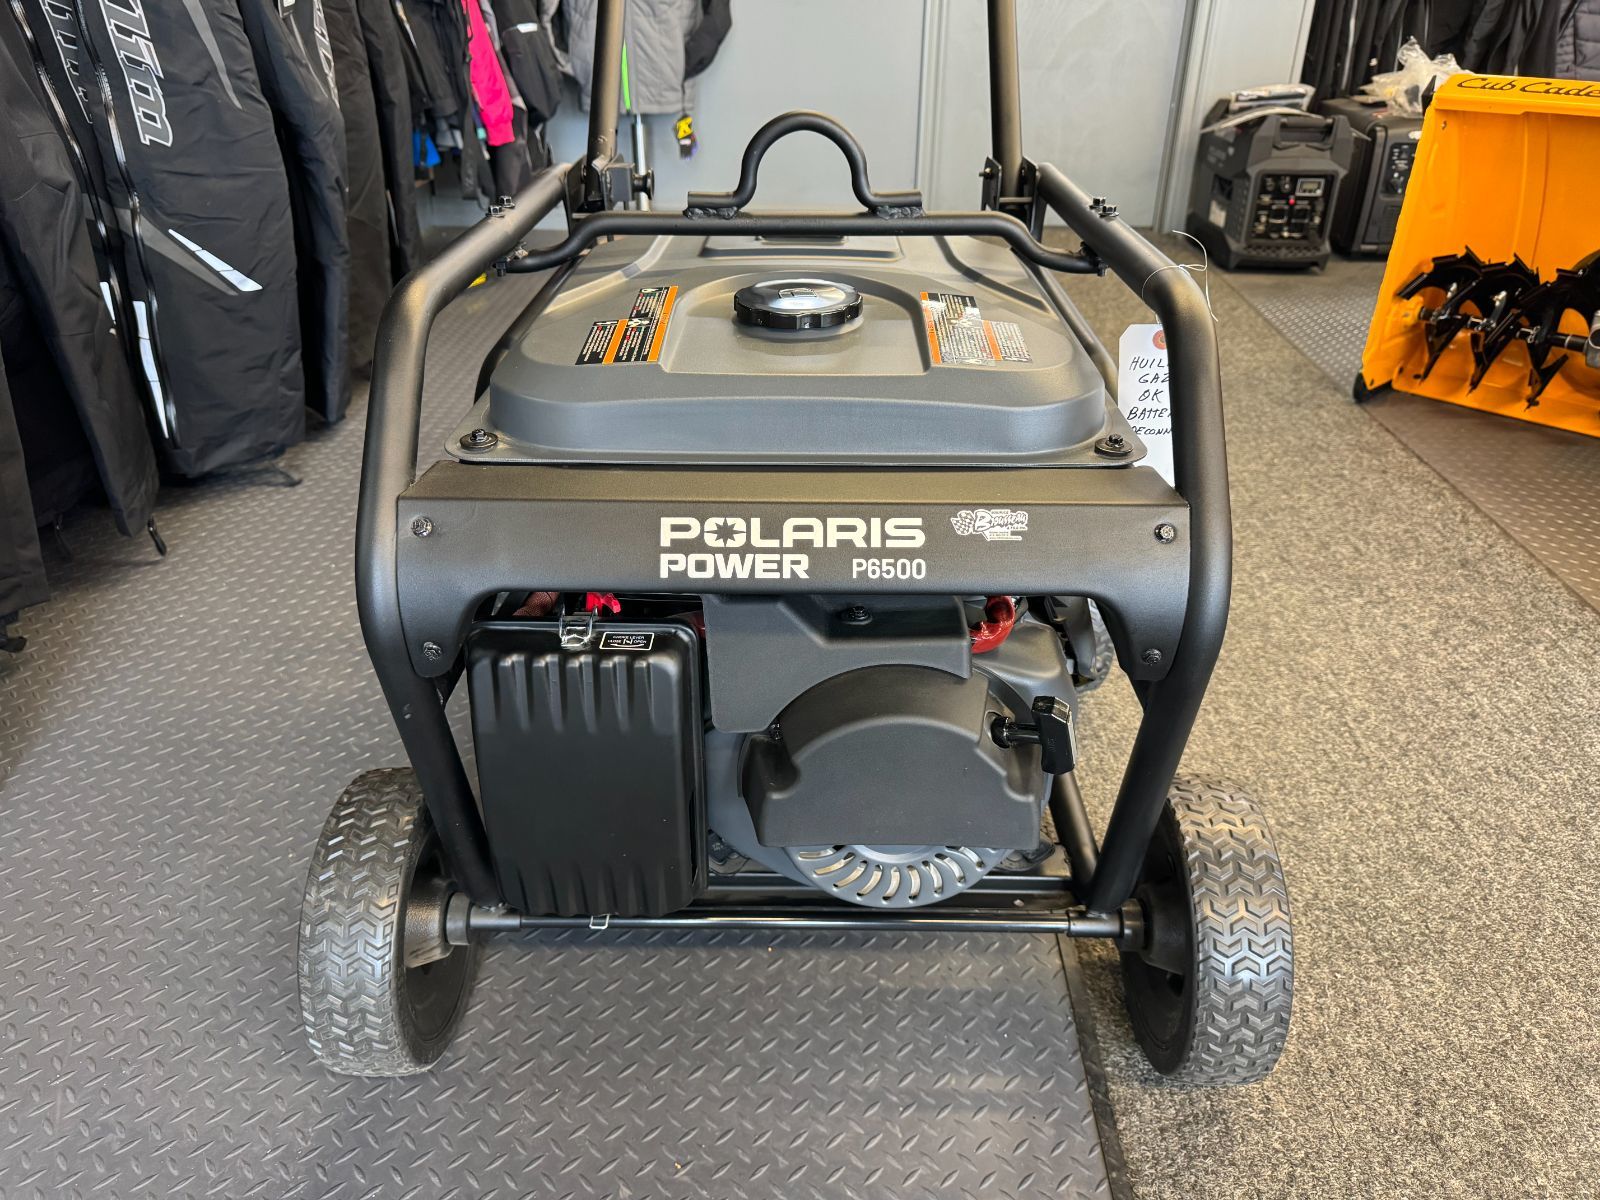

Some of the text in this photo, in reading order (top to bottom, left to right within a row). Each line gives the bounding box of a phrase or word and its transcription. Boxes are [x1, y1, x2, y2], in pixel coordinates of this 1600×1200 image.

[1457, 77, 1517, 91] Cub
[1129, 356, 1168, 371] HUIL
[1138, 388, 1164, 403] OK
[1126, 406, 1171, 421] BATTE
[660, 516, 926, 548] POLARIS
[659, 553, 926, 580] POWER P6500
